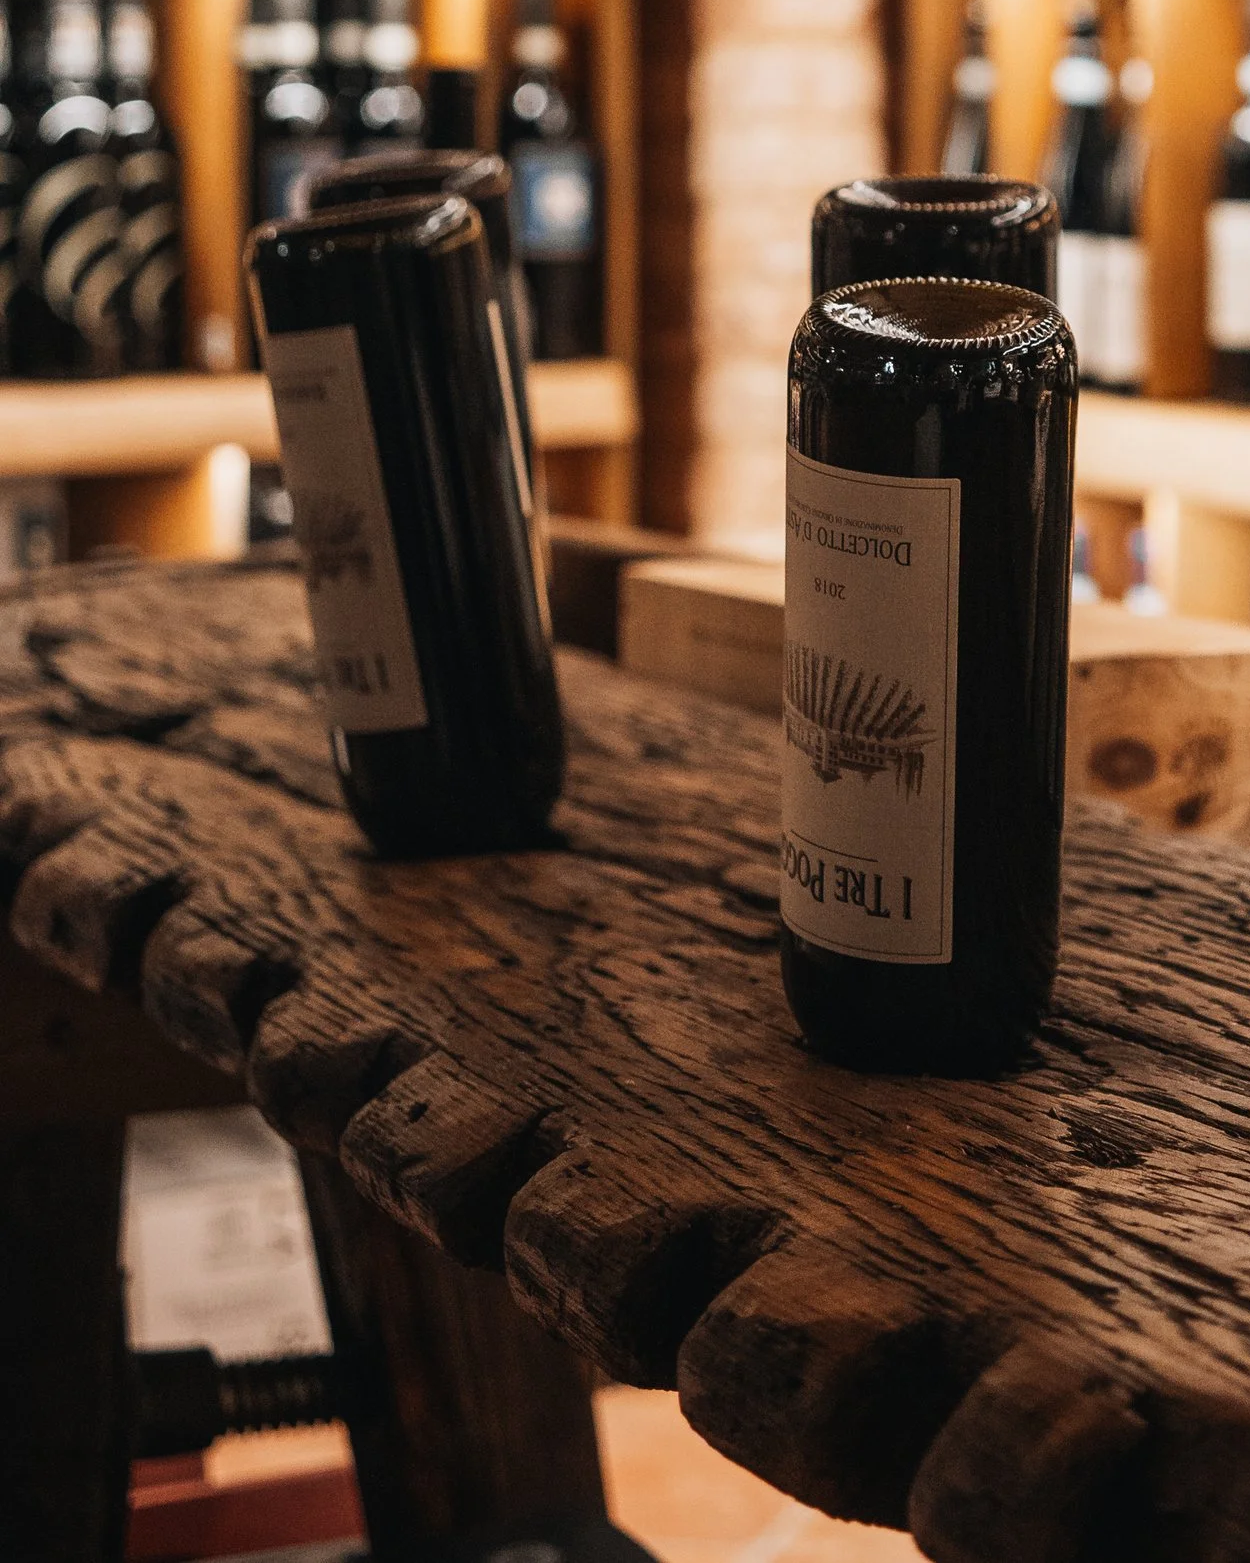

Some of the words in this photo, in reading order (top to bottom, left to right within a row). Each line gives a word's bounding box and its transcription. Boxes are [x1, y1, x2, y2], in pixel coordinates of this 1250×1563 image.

[818, 526, 912, 567] DOLCETTO
[813, 577, 846, 600] 2018
[834, 865, 891, 919] TRE
[902, 876, 913, 921] I
